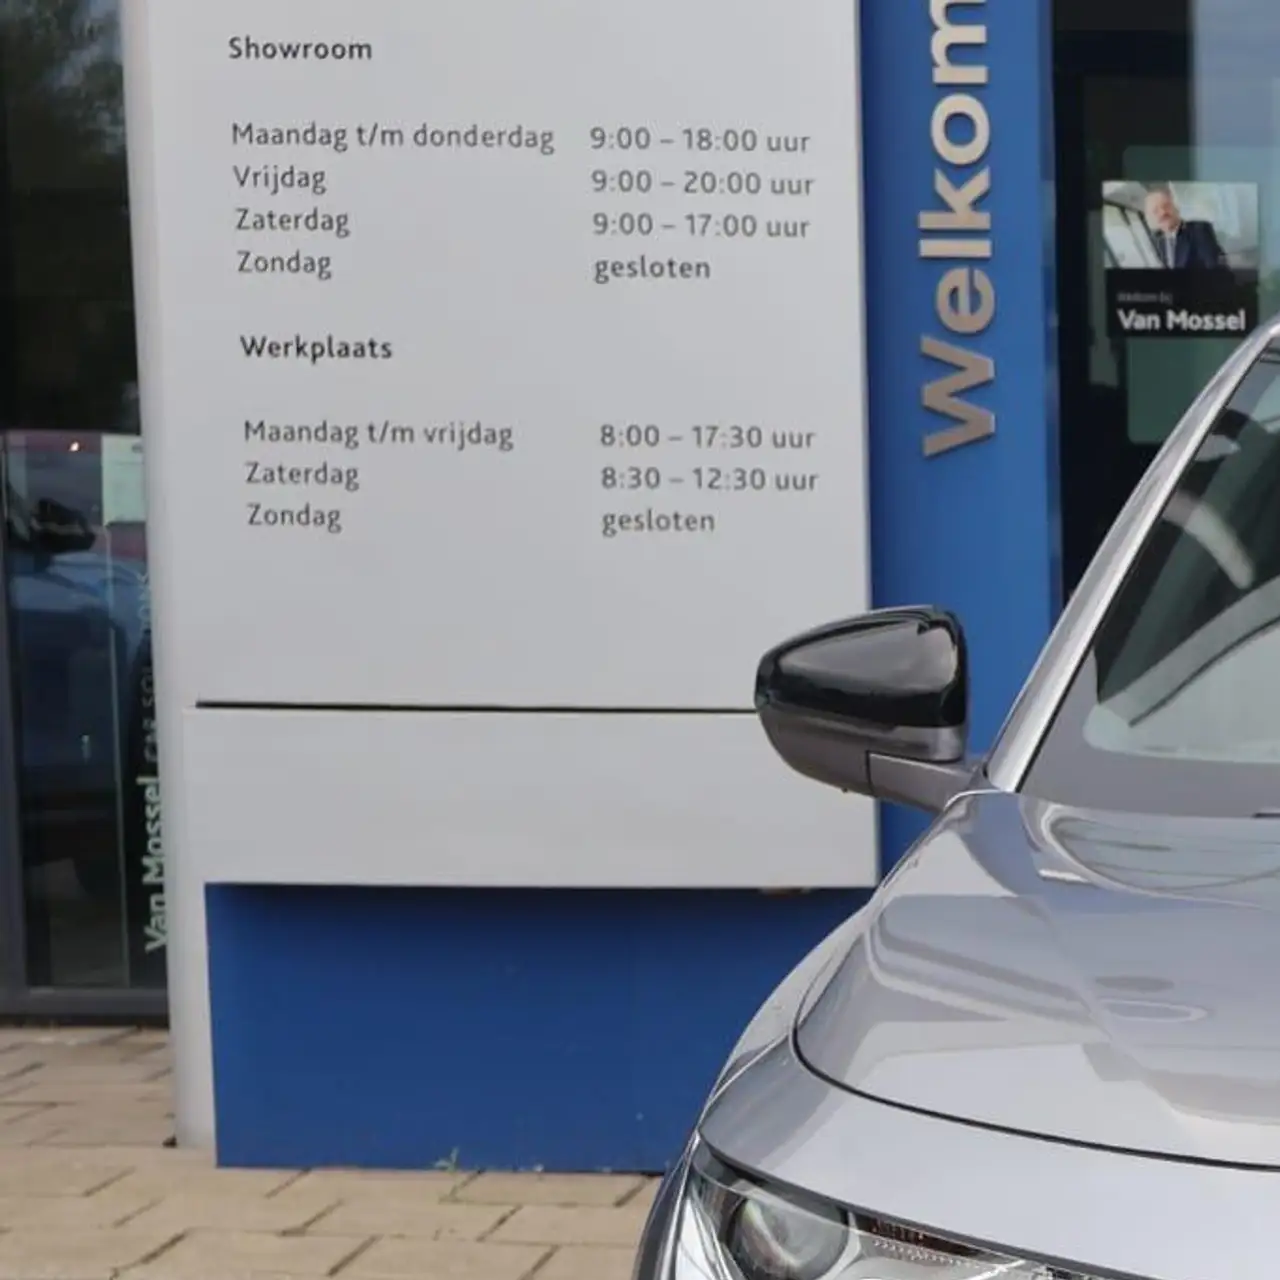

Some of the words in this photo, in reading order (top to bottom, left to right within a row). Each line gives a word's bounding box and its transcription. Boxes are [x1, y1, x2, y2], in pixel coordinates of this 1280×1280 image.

[228, 34, 373, 61] Showroom
[231, 120, 349, 154] Maandag
[355, 121, 405, 148] t/m
[412, 122, 556, 156] donderdag
[589, 126, 651, 150] 9:00
[682, 127, 758, 152] 18:00
[766, 135, 811, 153] uur
[232, 164, 328, 197] Vrijdag
[590, 169, 653, 194] 9:00
[683, 170, 762, 195] 20:00
[770, 178, 815, 196] uur
[235, 206, 352, 240] Zaterdag
[592, 211, 654, 236] 9:00
[684, 213, 758, 238] 17:00
[765, 220, 811, 239] uur
[918, 0, 996, 458] Welkom
[236, 248, 333, 282] Zondag
[592, 254, 711, 285] gesloten
[1117, 309, 1161, 331] Van
[1166, 308, 1246, 331] Mossel
[239, 333, 393, 366] Werkplaats
[243, 419, 360, 451] Maandag
[366, 419, 415, 444] t/m
[423, 420, 514, 452] vrijdag
[599, 423, 660, 448] 8:00
[691, 424, 763, 449] 17:30
[771, 431, 816, 449] uur
[245, 460, 360, 493] Zaterdag
[600, 465, 661, 490] 8:30
[692, 467, 766, 491] 12:30
[774, 473, 819, 492] uur
[247, 501, 343, 534] Zondag
[601, 507, 715, 539] gesloten
[135, 775, 165, 886] Mossel
[143, 892, 169, 954] Van
